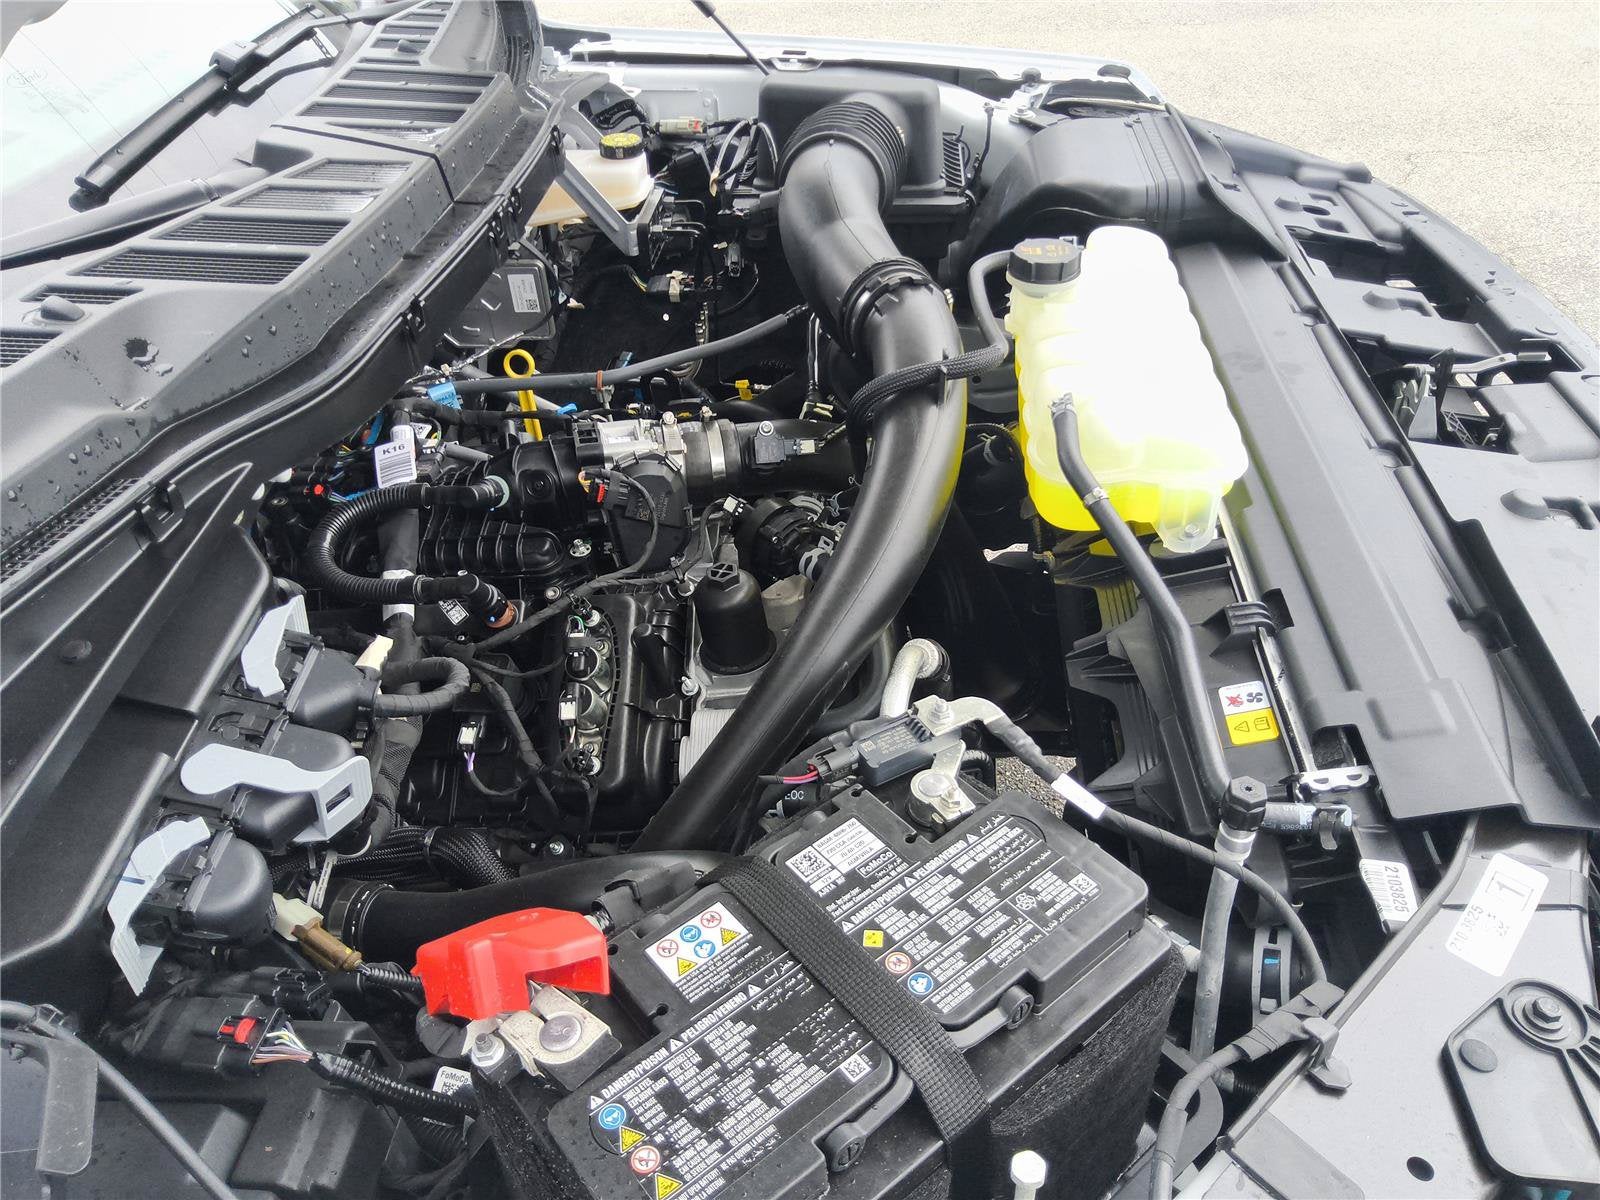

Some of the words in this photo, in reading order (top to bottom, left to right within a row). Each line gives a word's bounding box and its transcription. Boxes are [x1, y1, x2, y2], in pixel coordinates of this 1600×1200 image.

[382, 444, 405, 455] K16
[858, 850, 893, 875] FoMoCo
[849, 882, 906, 925] DANGER/POISON
[911, 838, 968, 880] PELIGRO/VENENO
[1384, 866, 1410, 912] 2103825
[1496, 881, 1526, 897] 1
[830, 907, 843, 917] Ford
[601, 1046, 670, 1101] DANGER/POISON
[680, 989, 748, 1043] PELIGRO/VENENO
[767, 1041, 788, 1059] CHISPAS
[755, 1057, 766, 1067] NO
[772, 1047, 792, 1065] FLAMAS
[441, 1070, 469, 1085] FoMoCo
[717, 1084, 729, 1096] LES
[723, 1090, 734, 1102] LES
[731, 1075, 755, 1096] FLAMMES
[728, 1098, 738, 1108] DE
[735, 1086, 753, 1103] FUMER
[666, 1116, 688, 1134] SPARKS
[672, 1122, 693, 1140] FLAMES
[653, 1132, 665, 1143] NO
[677, 1126, 701, 1147] SMOKING
[693, 1137, 708, 1152] ACID
[725, 1154, 737, 1165] PAS
[686, 1181, 701, 1196] OPEN
